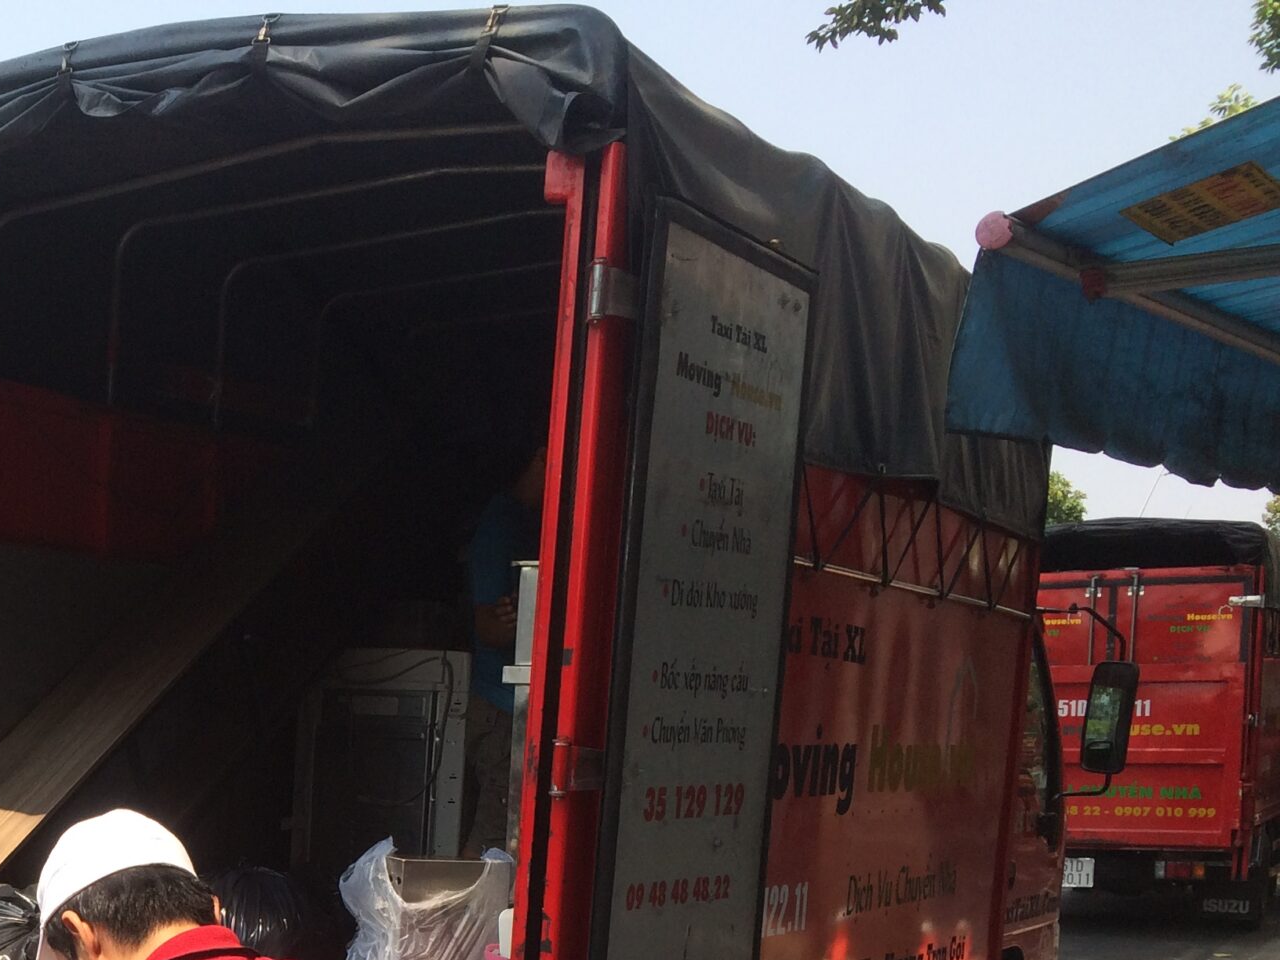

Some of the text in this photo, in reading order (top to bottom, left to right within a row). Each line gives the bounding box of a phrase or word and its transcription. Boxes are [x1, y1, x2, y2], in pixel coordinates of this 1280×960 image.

[753, 331, 768, 354] XL
[676, 352, 722, 398] Moving
[643, 782, 745, 822] 35 129 129
[1083, 805, 1101, 816] 22
[1115, 806, 1151, 817] 0907
[1156, 807, 1183, 817] 010
[1188, 808, 1216, 818] 999
[626, 883, 644, 910] 09
[649, 881, 666, 907] 48
[671, 878, 688, 904] 48
[1203, 898, 1250, 914] ISUZU
